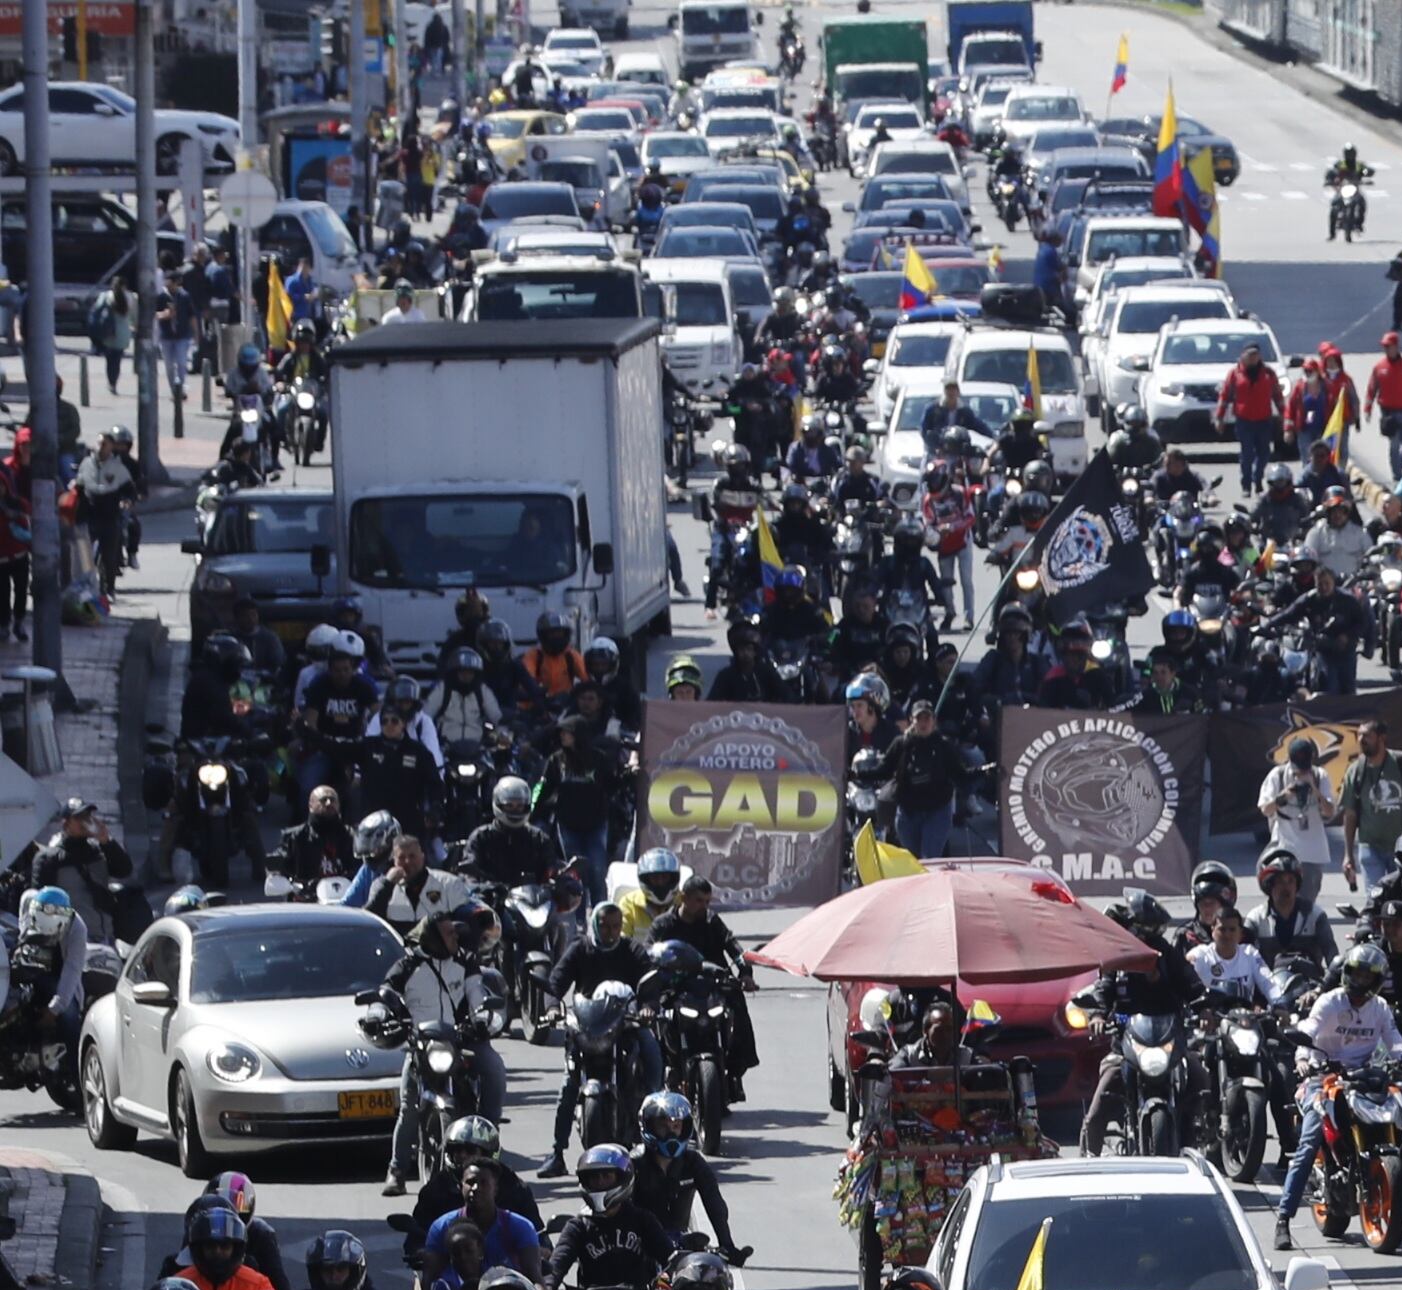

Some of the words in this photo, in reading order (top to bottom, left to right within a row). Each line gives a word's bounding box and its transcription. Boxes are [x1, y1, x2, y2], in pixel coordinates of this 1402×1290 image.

[713, 742, 776, 757] APOYO
[1058, 721, 1083, 740] DE
[1082, 718, 1174, 784] APLICACIÓN
[698, 755, 777, 770] MOTERO
[1010, 732, 1056, 791] MOTERO
[648, 771, 839, 833] GAD
[1009, 794, 1046, 853] GREMIO
[1135, 778, 1181, 856] COLOMBIA
